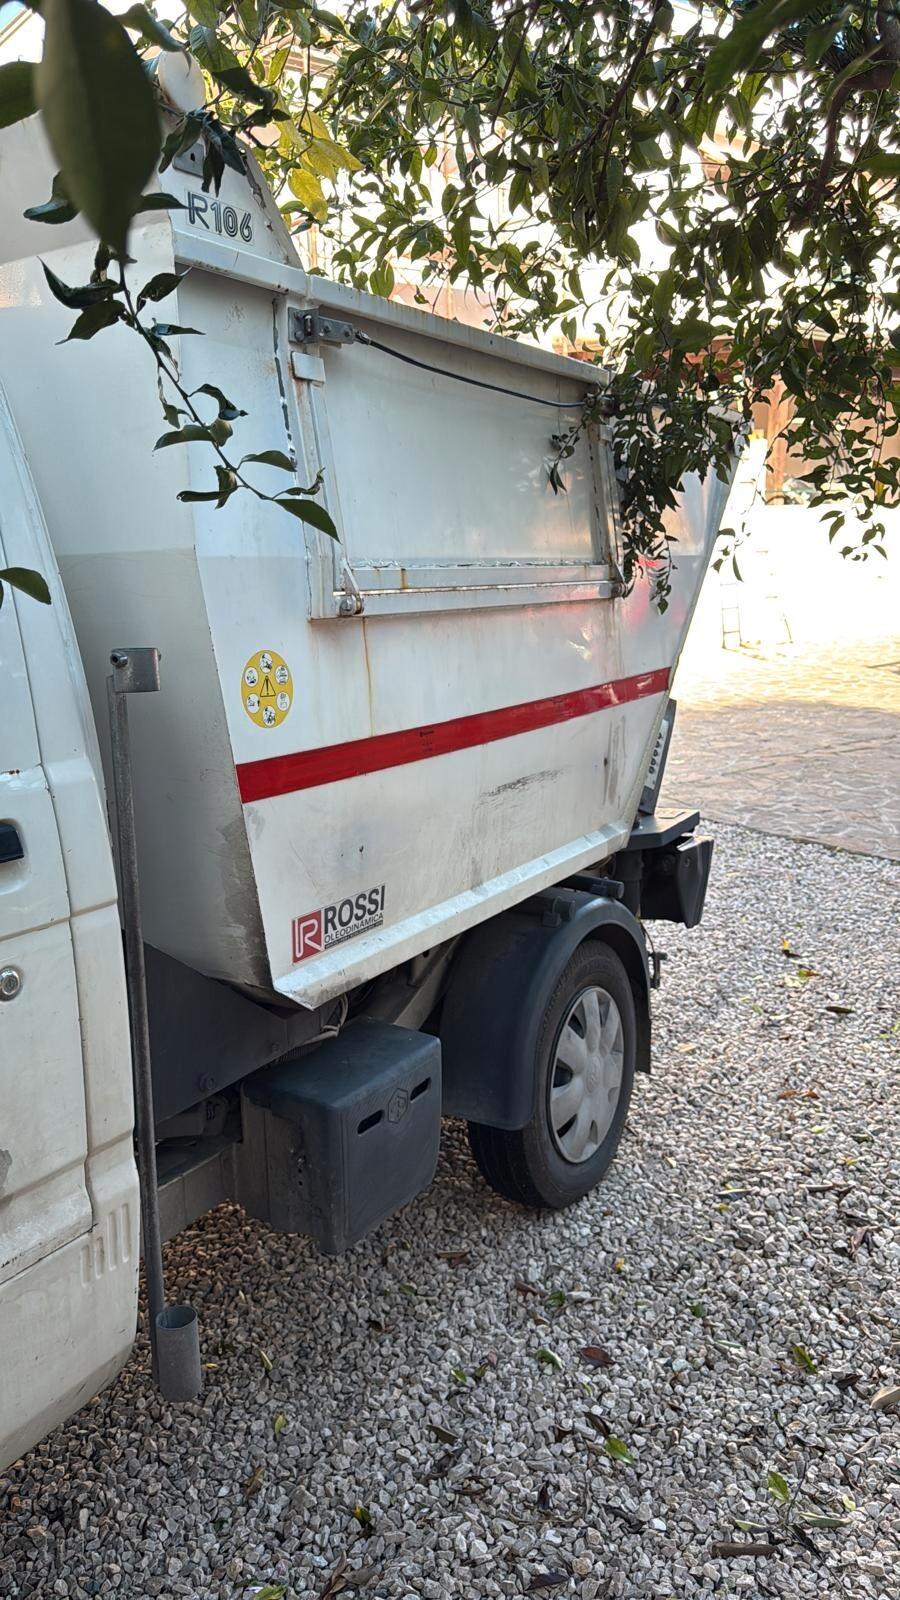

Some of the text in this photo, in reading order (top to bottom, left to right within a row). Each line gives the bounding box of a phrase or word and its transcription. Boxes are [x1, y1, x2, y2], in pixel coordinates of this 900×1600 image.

[187, 190, 253, 243] R106
[325, 885, 386, 935] ROSSI
[325, 912, 384, 944] OLEODINAMICA
